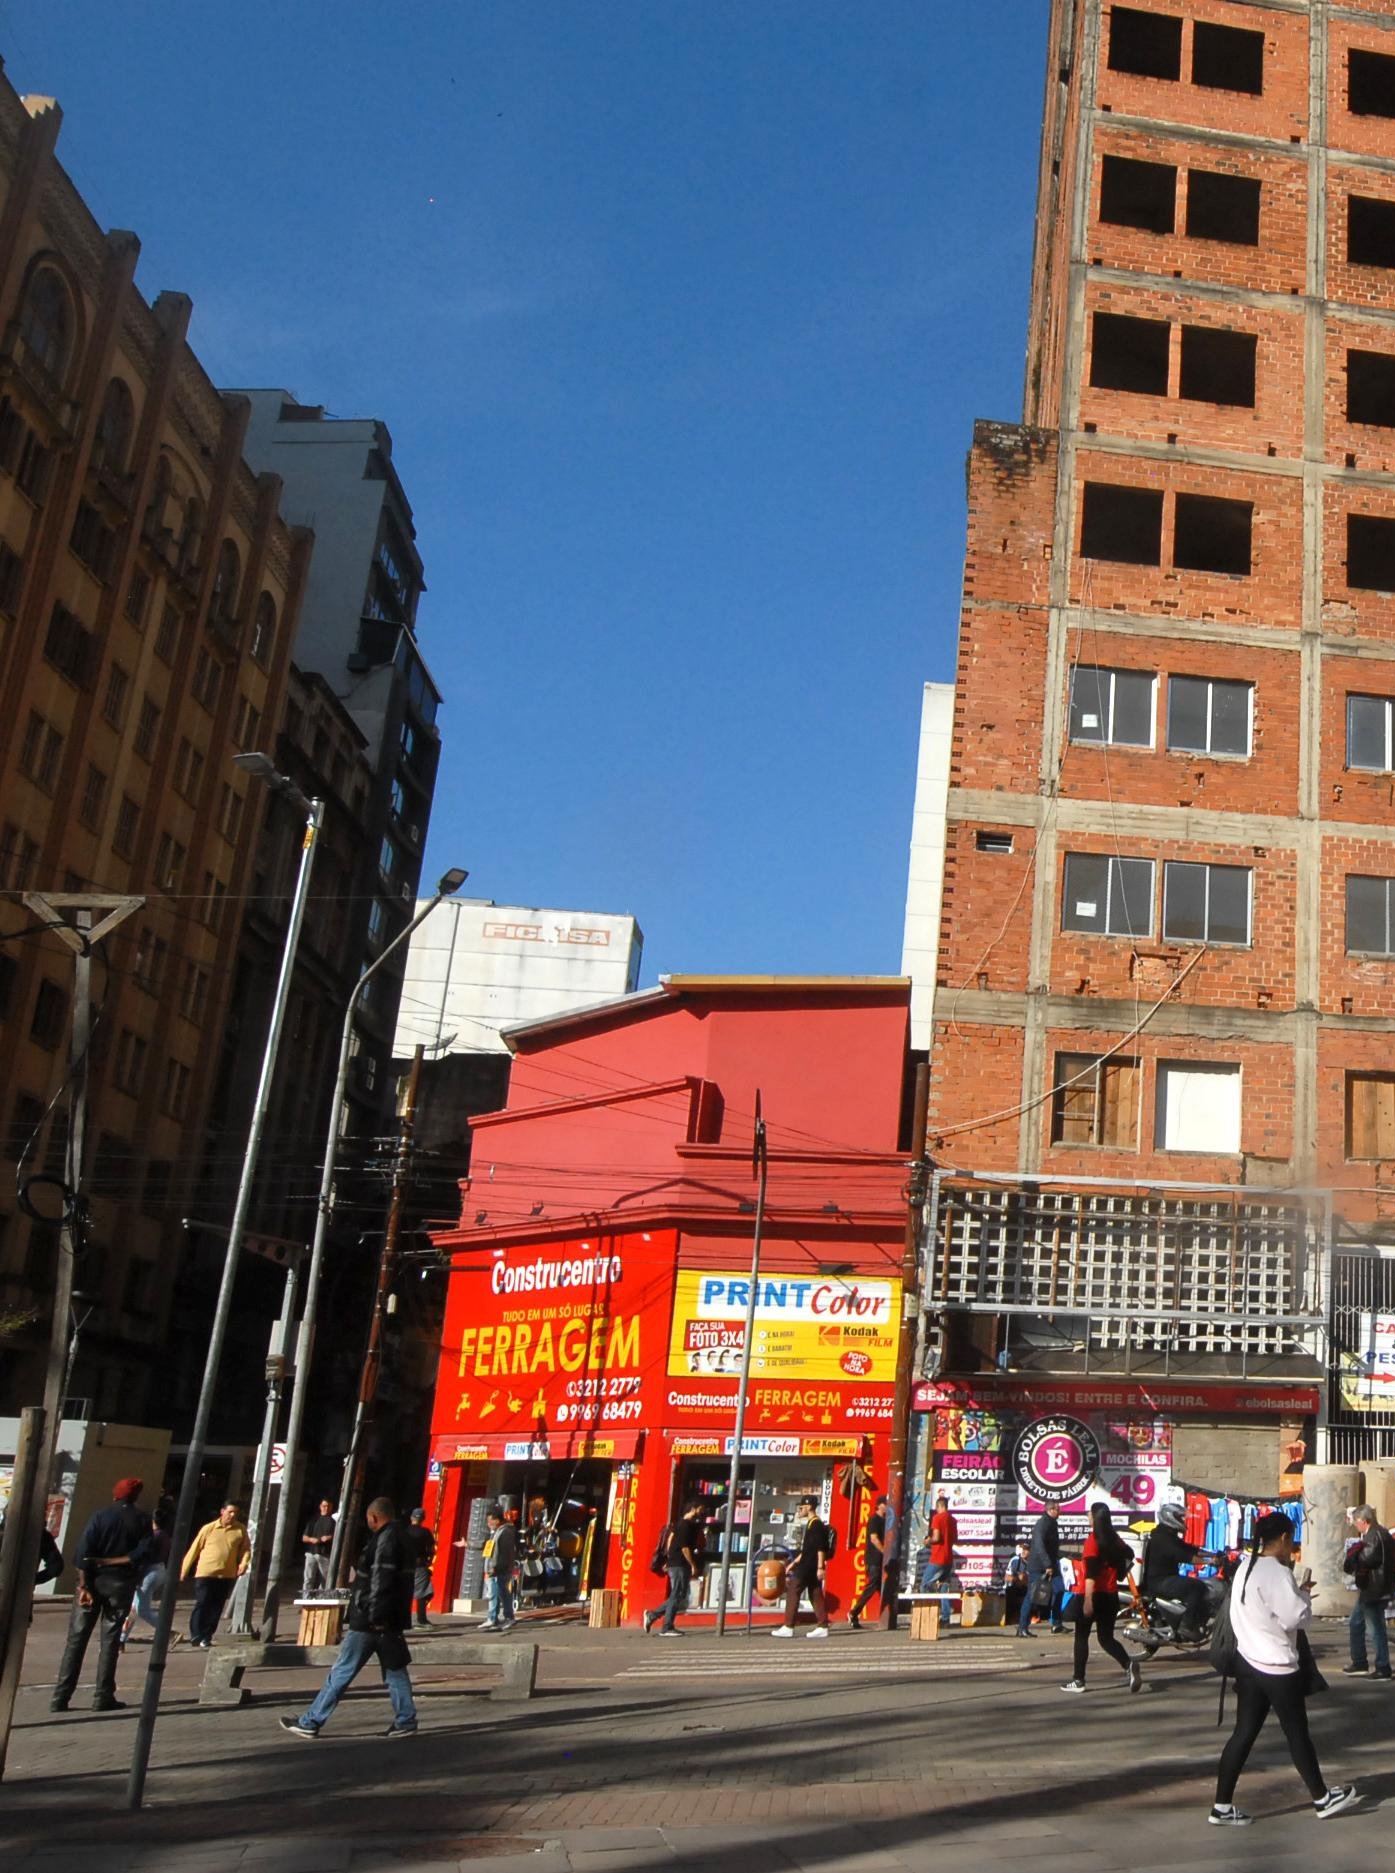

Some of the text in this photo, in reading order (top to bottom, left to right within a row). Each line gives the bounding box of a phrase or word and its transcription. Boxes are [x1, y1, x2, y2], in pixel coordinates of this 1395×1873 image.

[491, 1254, 622, 1295] Construcentro
[704, 1279, 886, 1316] PRINT Color
[502, 1302, 605, 1323] TUDO EM UM SÓ LUGAR
[689, 1321, 726, 1333] FAÇA SUA
[843, 1326, 879, 1337] Kodak
[458, 1314, 641, 1377] FERRAGEM
[689, 1331, 744, 1348] FOTO 3X4
[868, 1338, 894, 1348] FILM
[848, 1351, 868, 1363] FOTO
[576, 1379, 606, 1397] 3212
[667, 1391, 750, 1408] Construcento
[754, 1389, 842, 1407] FERRAGEM
[858, 1396, 880, 1407] 3212
[917, 1389, 1209, 1407] SEJAM BEM-VINDOS! ENTRE E CONFIRA.
[570, 1400, 642, 1422] 9969 68479
[854, 1408, 876, 1418] 9969
[506, 1443, 531, 1456] PRINT
[671, 1444, 720, 1454] FERRAGEM
[673, 1436, 720, 1446] Construcentro
[727, 1439, 798, 1453] PINT Color
[822, 1439, 846, 1448] Kodak
[1018, 1419, 1098, 1463] BOLSAS LEAL
[942, 1452, 1005, 1469] FEIRÃO
[1045, 1441, 1069, 1474] É
[1106, 1453, 1168, 1465] MOCHILAS
[940, 1468, 1005, 1481] ESCOLAR
[1019, 1465, 1047, 1499] DIRETO
[1046, 1491, 1061, 1500] DE
[1110, 1475, 1156, 1505] 49
